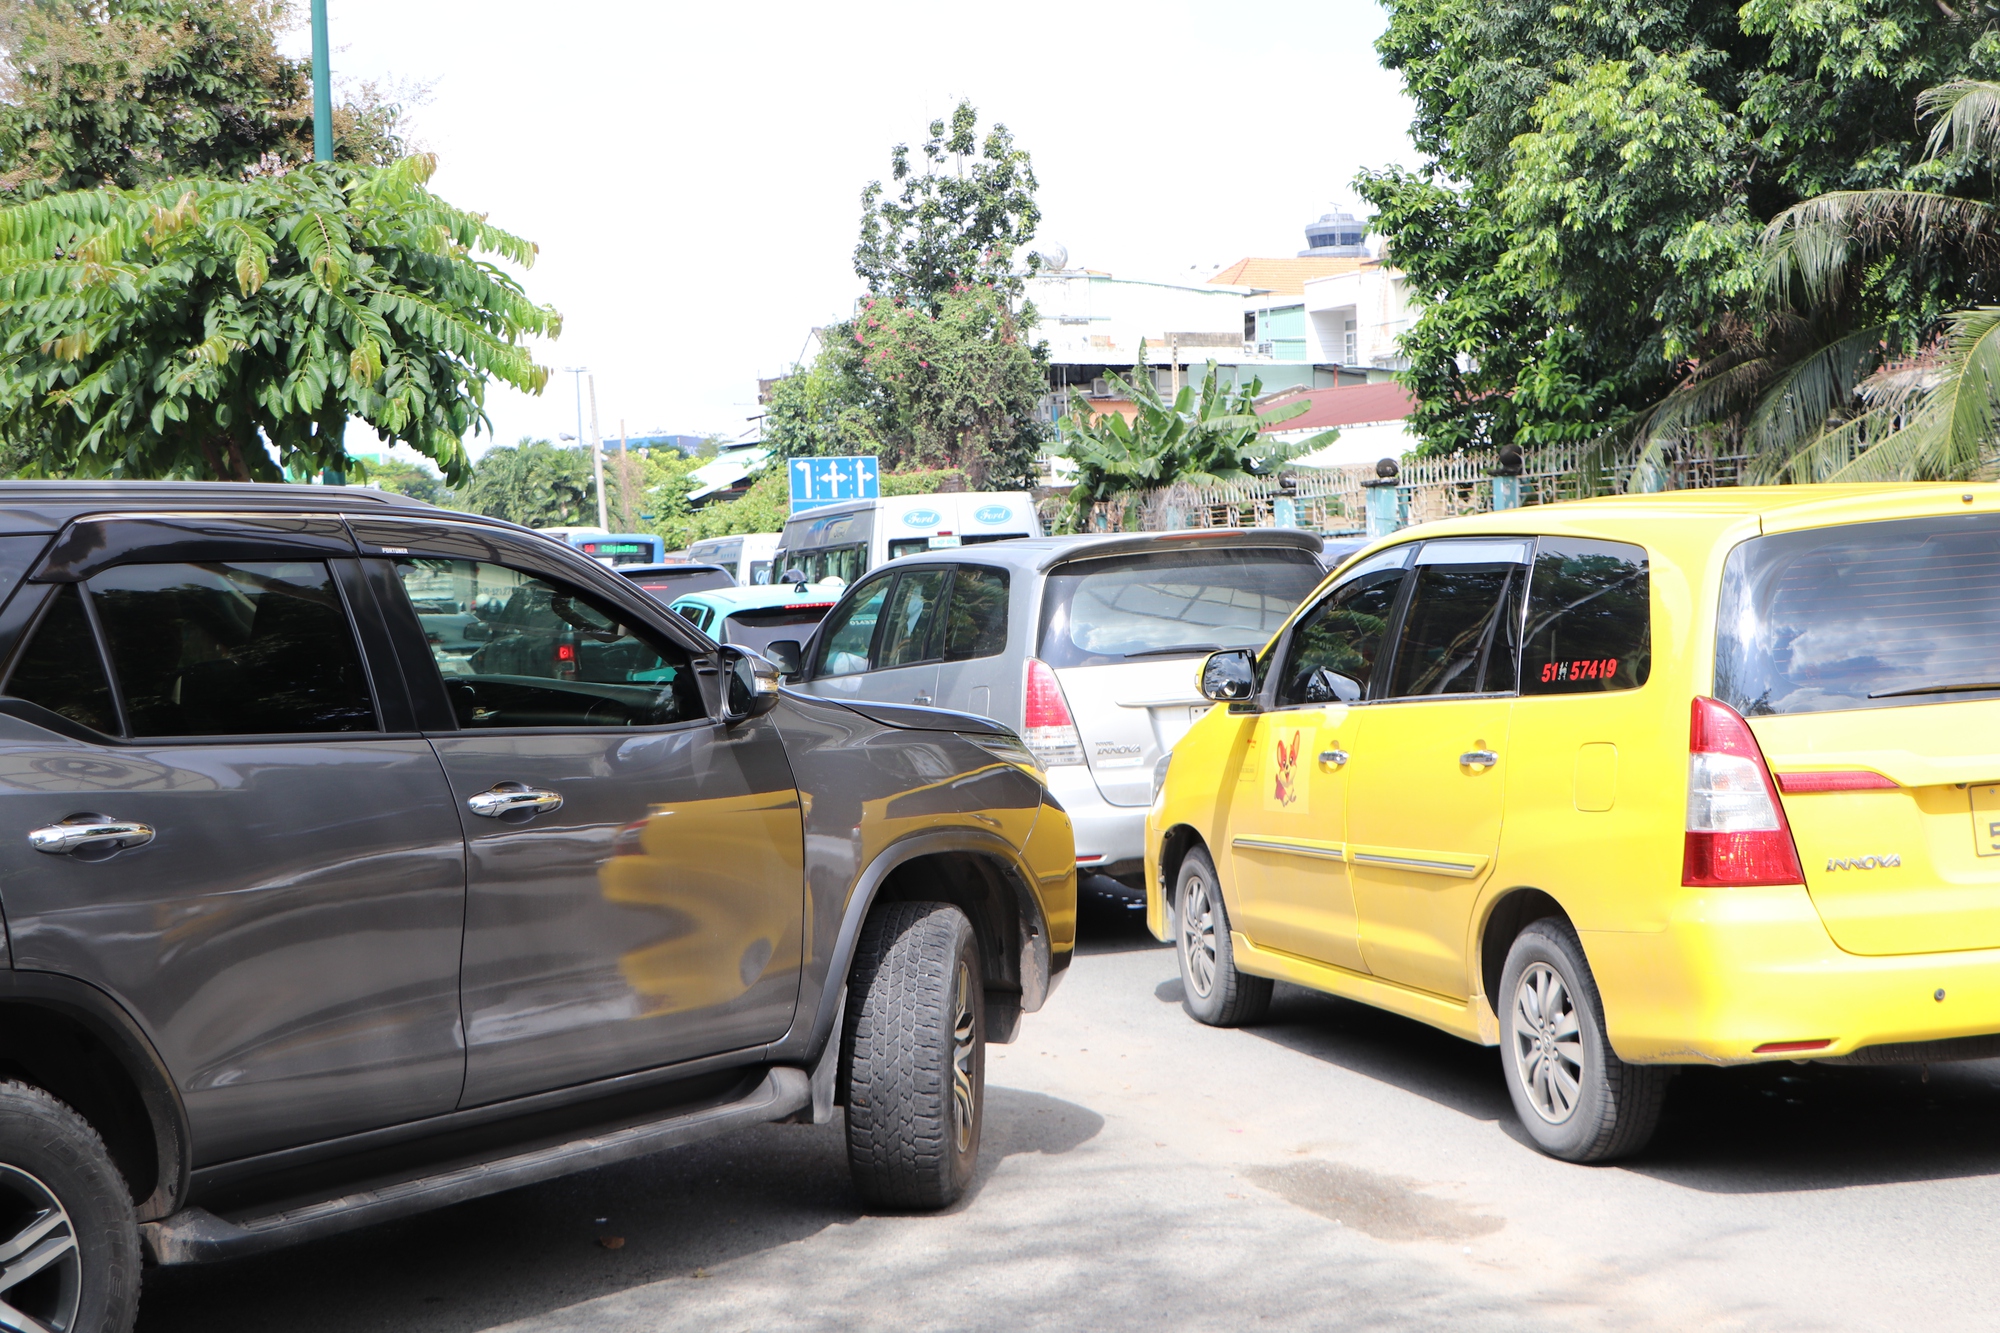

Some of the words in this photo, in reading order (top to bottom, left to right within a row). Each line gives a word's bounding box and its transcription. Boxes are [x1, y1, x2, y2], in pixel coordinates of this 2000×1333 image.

[907, 512, 936, 524] Ford
[979, 508, 1006, 521] Ford
[1569, 658, 1617, 681] 57419
[1097, 744, 1141, 755] INNOVA
[1826, 853, 1901, 872] INNOVA
